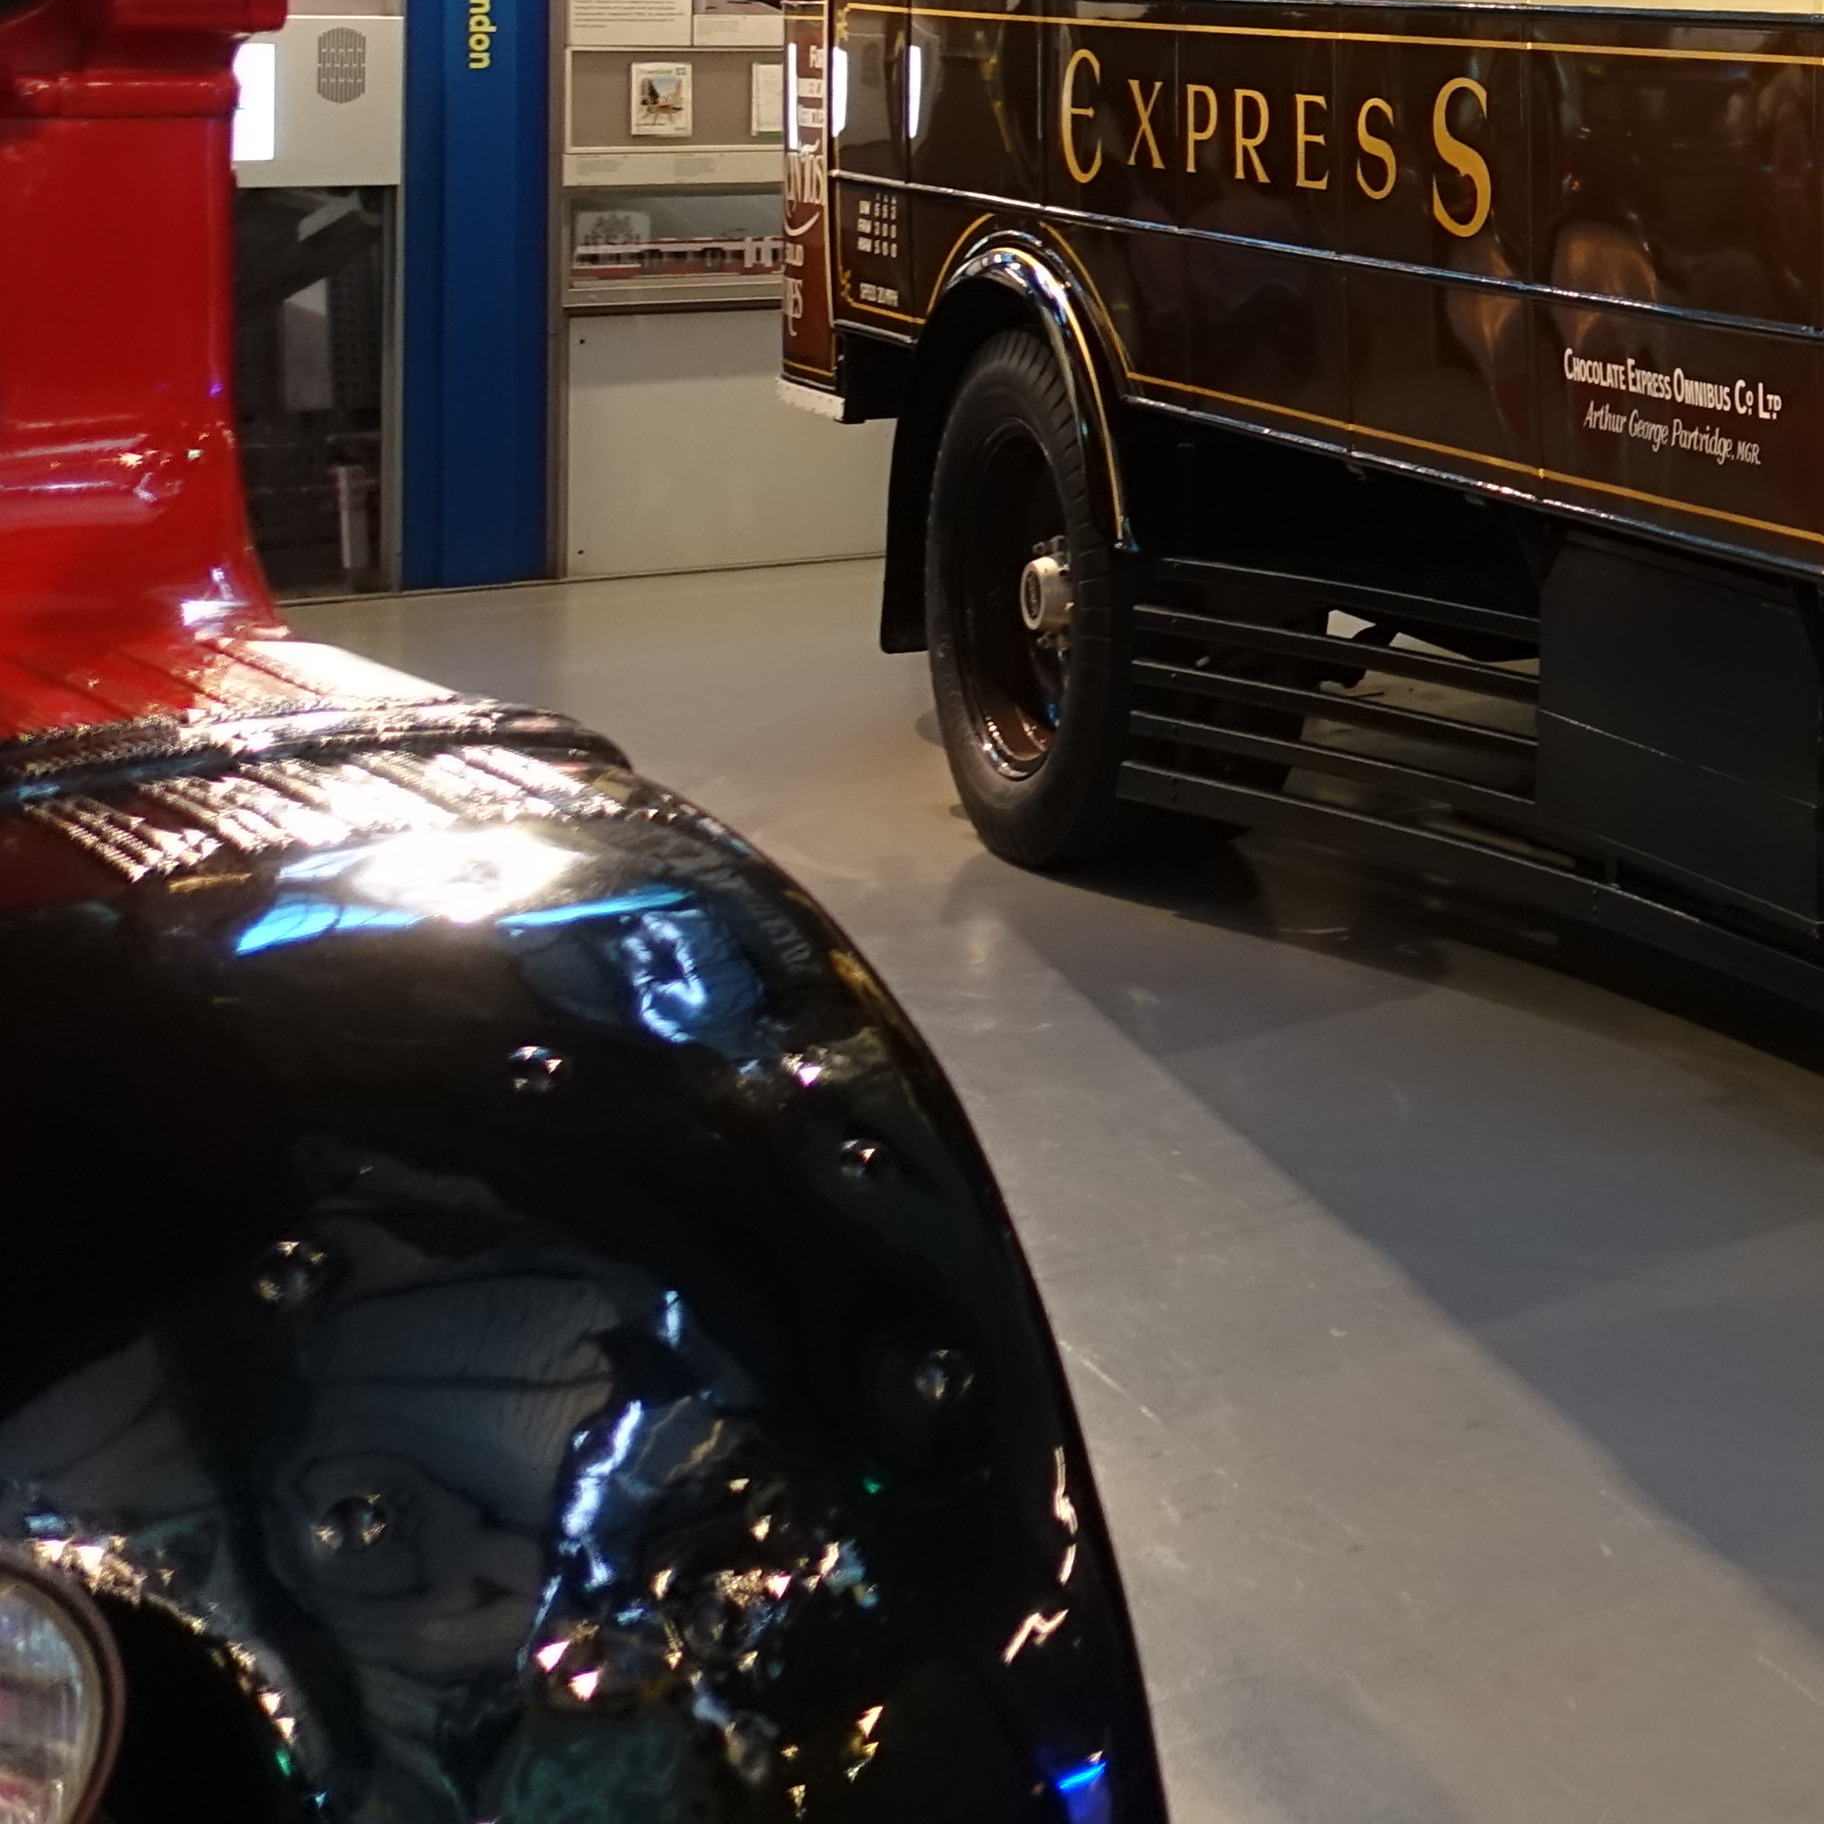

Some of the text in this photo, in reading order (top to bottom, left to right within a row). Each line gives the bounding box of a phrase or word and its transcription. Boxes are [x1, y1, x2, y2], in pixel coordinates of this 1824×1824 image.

[1060, 47, 1493, 238] EXPRESS
[1563, 347, 1626, 391] CHOCOLATE
[1626, 358, 1673, 400] EXPRESS
[1673, 367, 1732, 412] OMNIBUS
[1583, 400, 1627, 434] Arthur
[1628, 408, 1669, 453] George
